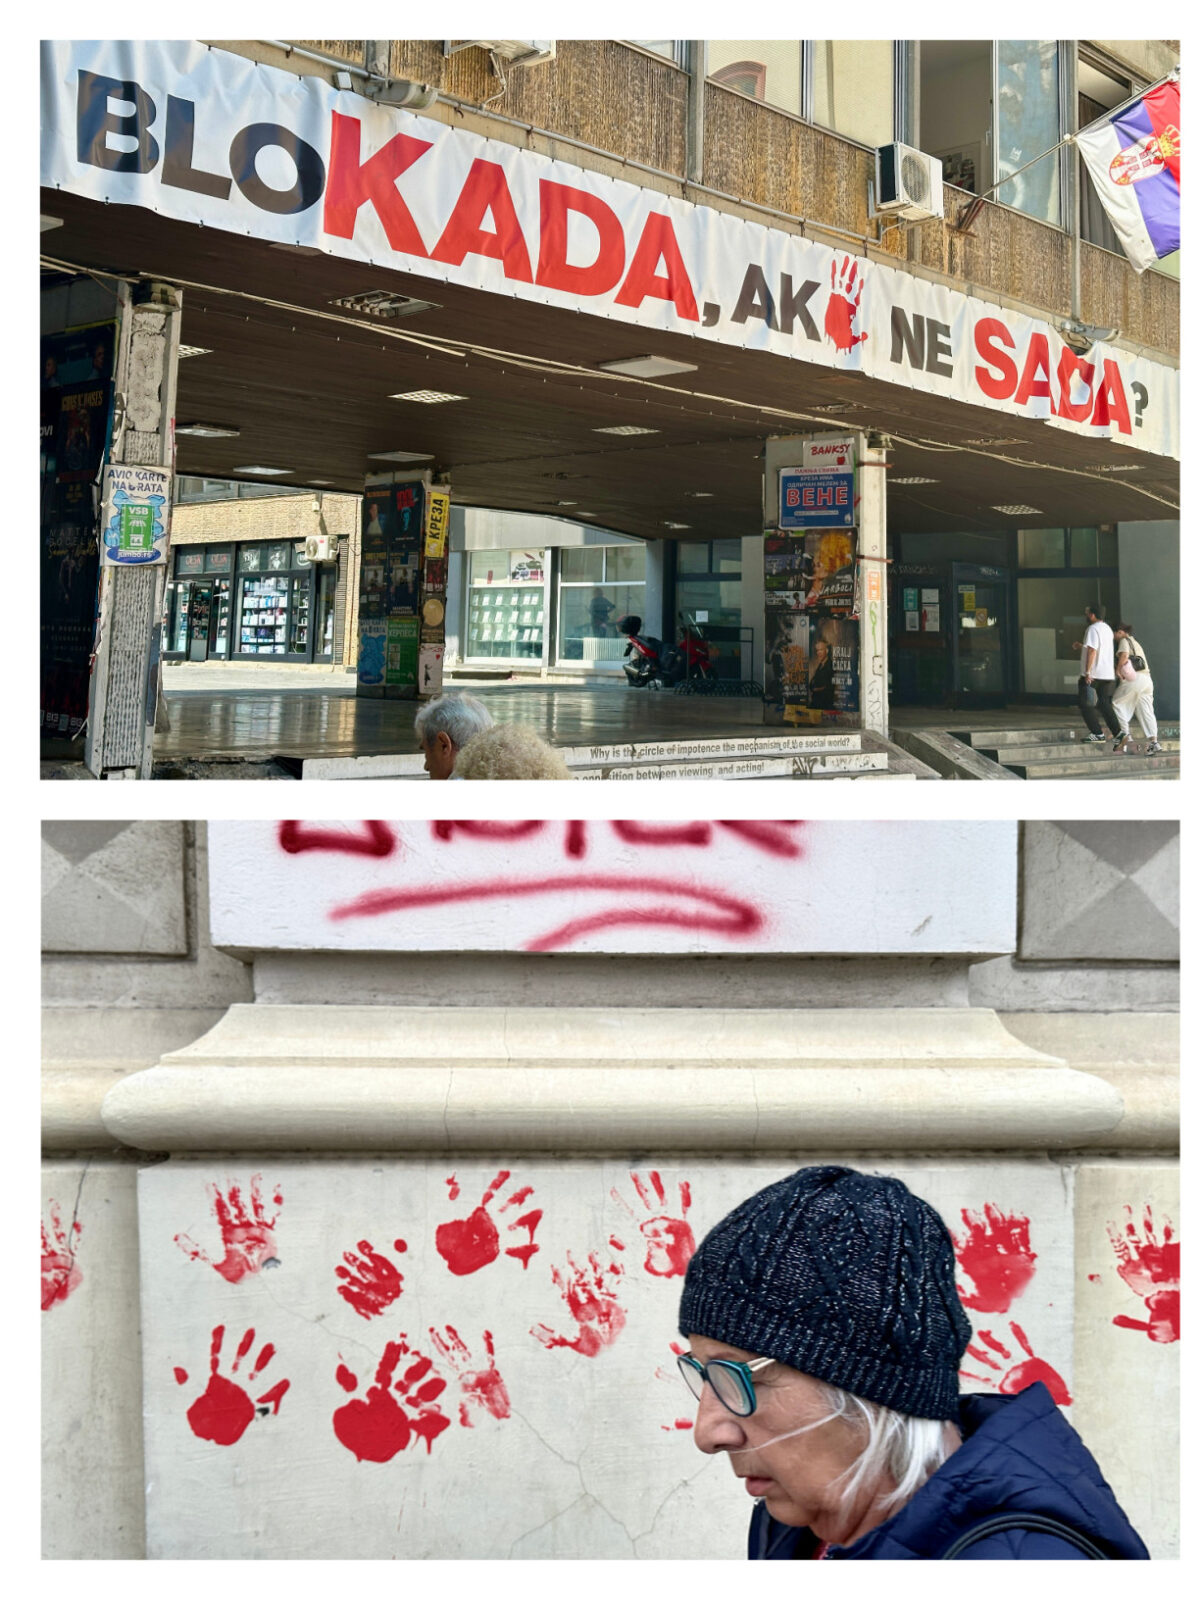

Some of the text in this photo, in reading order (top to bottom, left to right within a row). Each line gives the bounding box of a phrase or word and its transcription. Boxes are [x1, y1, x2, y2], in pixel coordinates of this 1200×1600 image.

[889, 306, 954, 378] NE
[811, 444, 850, 455] BANKSY
[108, 470, 167, 483] AVIO KARTE
[112, 482, 163, 492] NA RATA
[786, 487, 848, 507] ВЕНЕ
[129, 507, 148, 515] VSB
[429, 499, 443, 540] КРЕЗА
[591, 748, 610, 760] Why
[613, 748, 621, 758] is
[640, 746, 665, 757] circle
[667, 745, 677, 755] of
[677, 744, 721, 756] impotence
[723, 743, 735, 753] the
[738, 741, 782, 754] mechanism
[783, 740, 790, 750] of
[806, 738, 827, 748] social
[828, 737, 850, 747] world?
[637, 767, 678, 780] between
[681, 766, 715, 778] viewing
[719, 764, 736, 774] and
[738, 763, 767, 776] acting!
